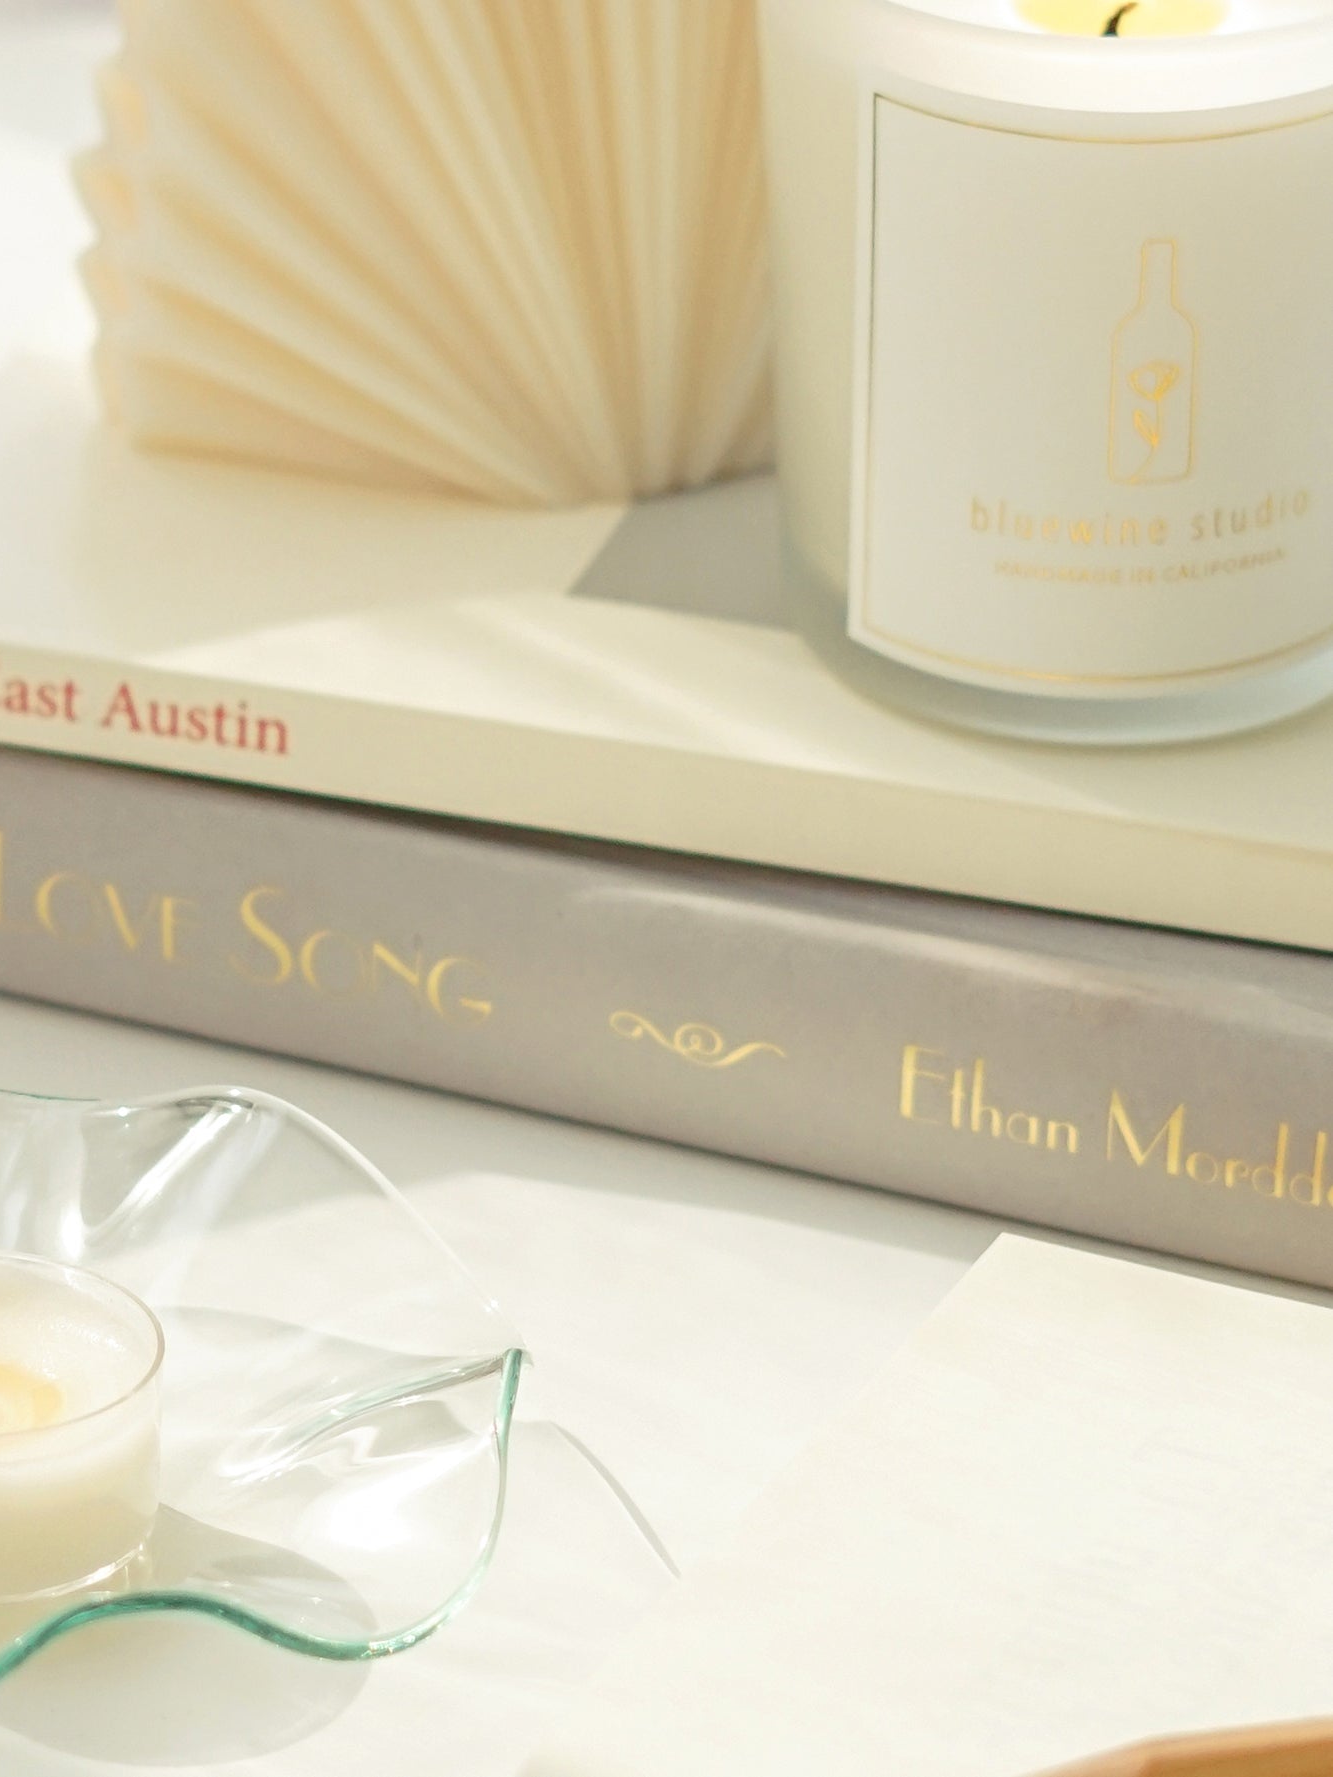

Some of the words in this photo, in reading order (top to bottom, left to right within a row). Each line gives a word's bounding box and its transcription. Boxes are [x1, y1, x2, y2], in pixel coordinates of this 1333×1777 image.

[1189, 487, 1311, 542] studio
[1162, 547, 1288, 584] CALIFORNIA
[100, 680, 291, 755] Austin
[228, 882, 494, 1029] SONG
[898, 1044, 1080, 1155] Ethan
